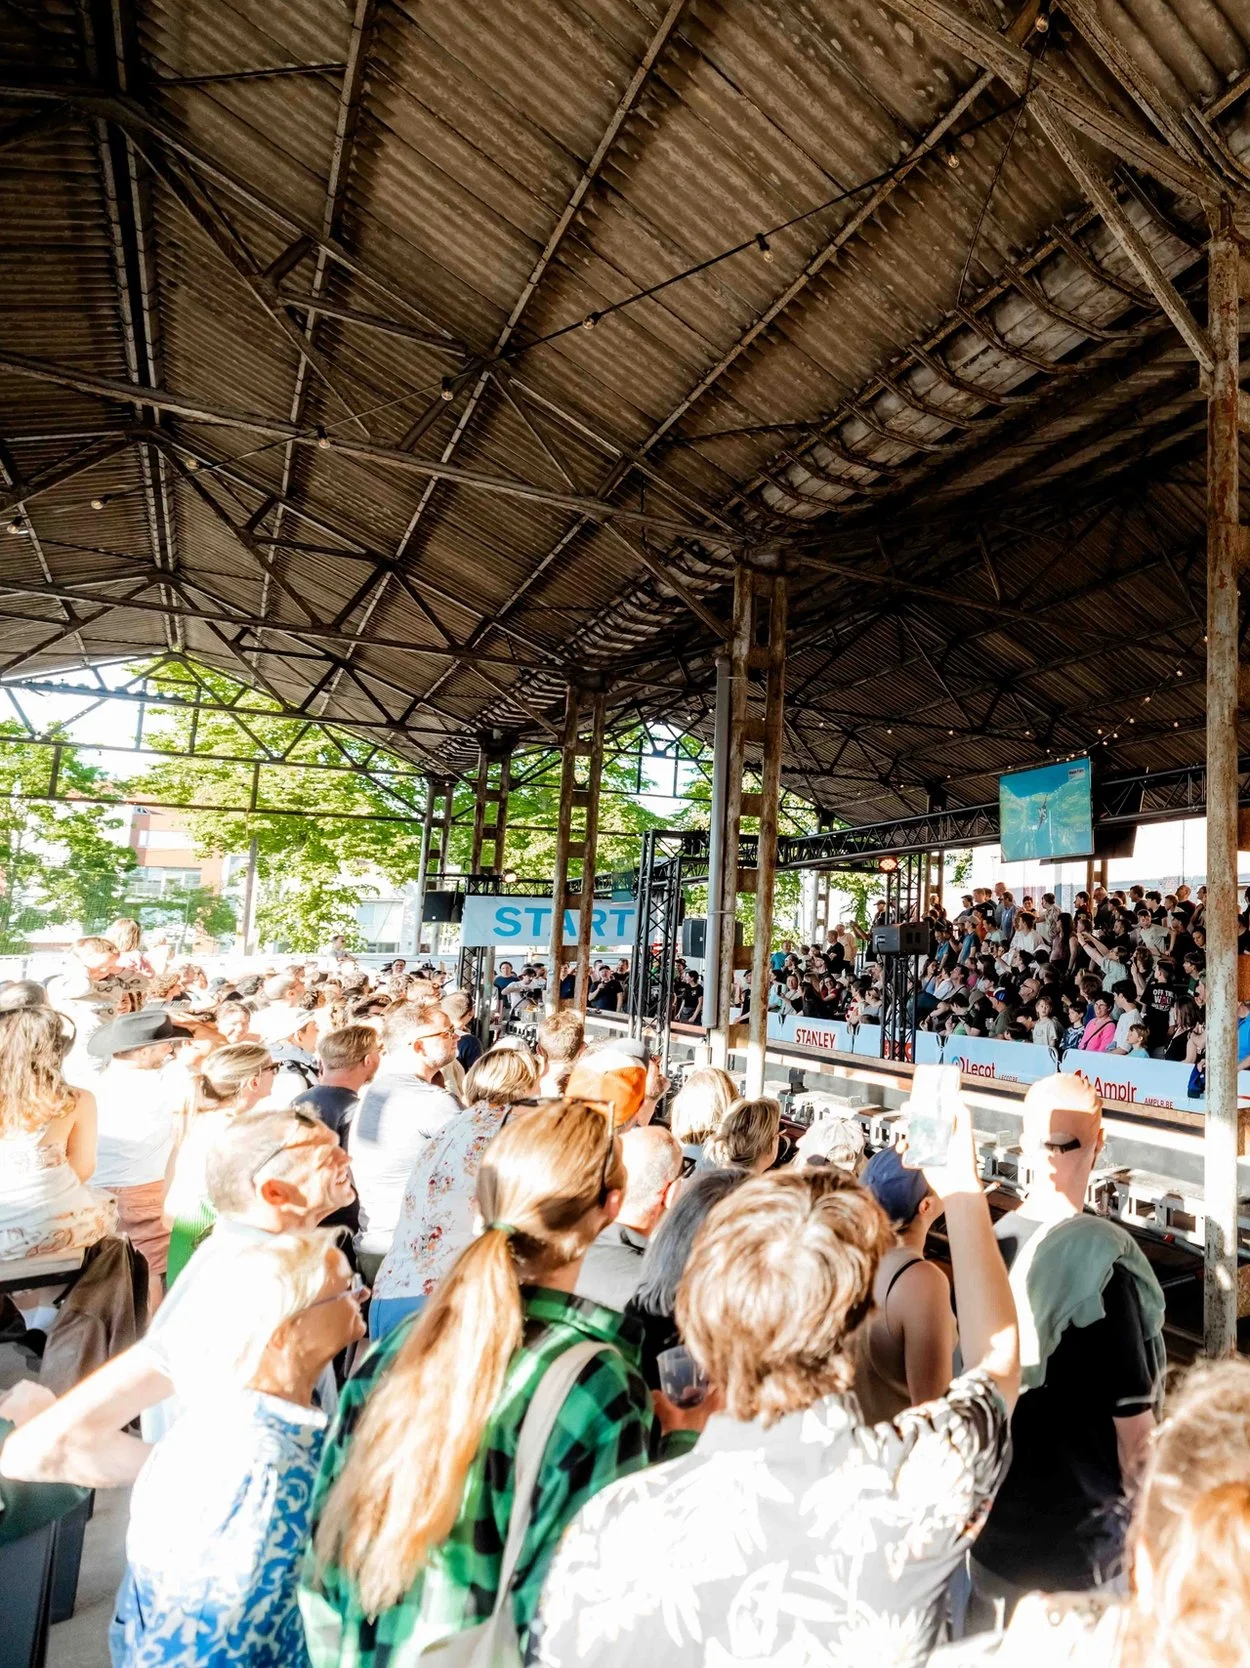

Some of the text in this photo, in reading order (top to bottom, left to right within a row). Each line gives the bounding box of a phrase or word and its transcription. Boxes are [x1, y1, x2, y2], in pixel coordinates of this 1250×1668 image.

[493, 907, 635, 937] START
[796, 1028, 836, 1049] STANLEY
[966, 1059, 995, 1078] Lecot
[1095, 1077, 1137, 1103] Amplr
[1144, 1097, 1174, 1109] AMPLR.BE
